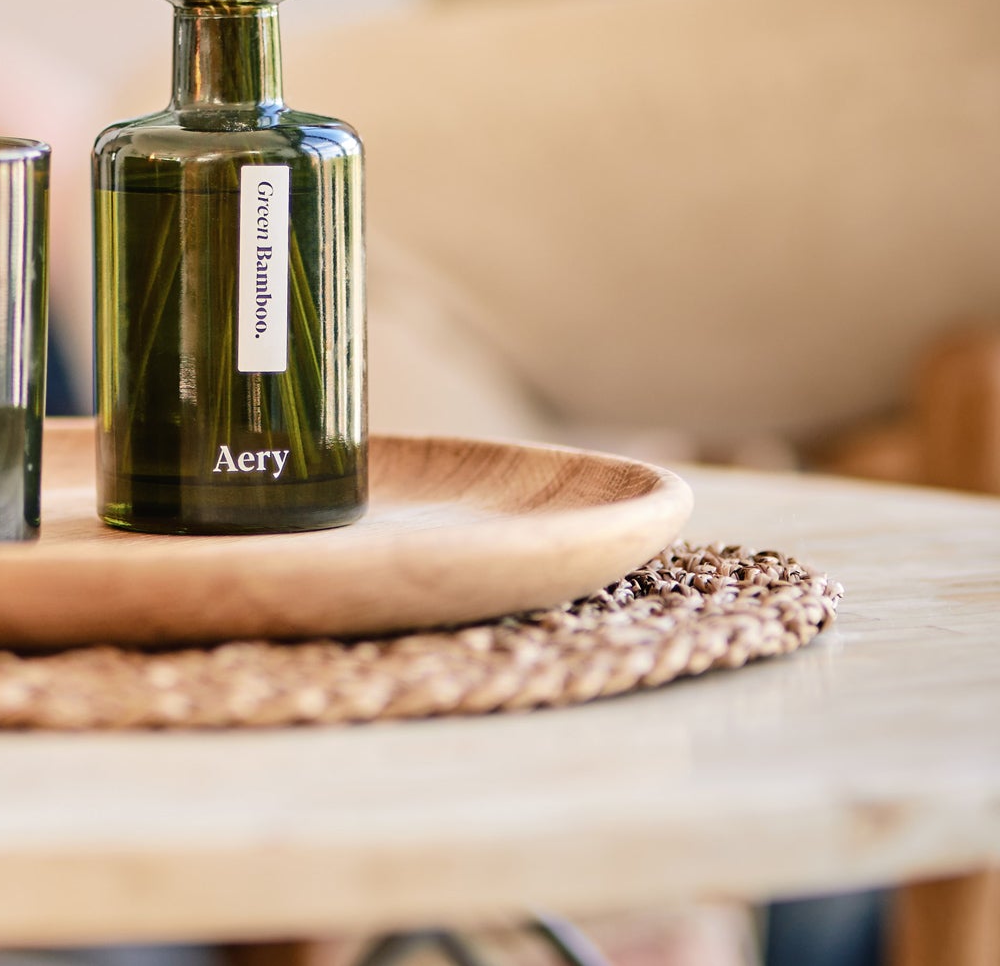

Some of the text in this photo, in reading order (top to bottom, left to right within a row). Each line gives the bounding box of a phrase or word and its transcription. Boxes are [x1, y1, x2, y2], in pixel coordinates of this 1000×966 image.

[255, 181, 274, 339] Green Bamboo.
[212, 445, 290, 479] Aery
